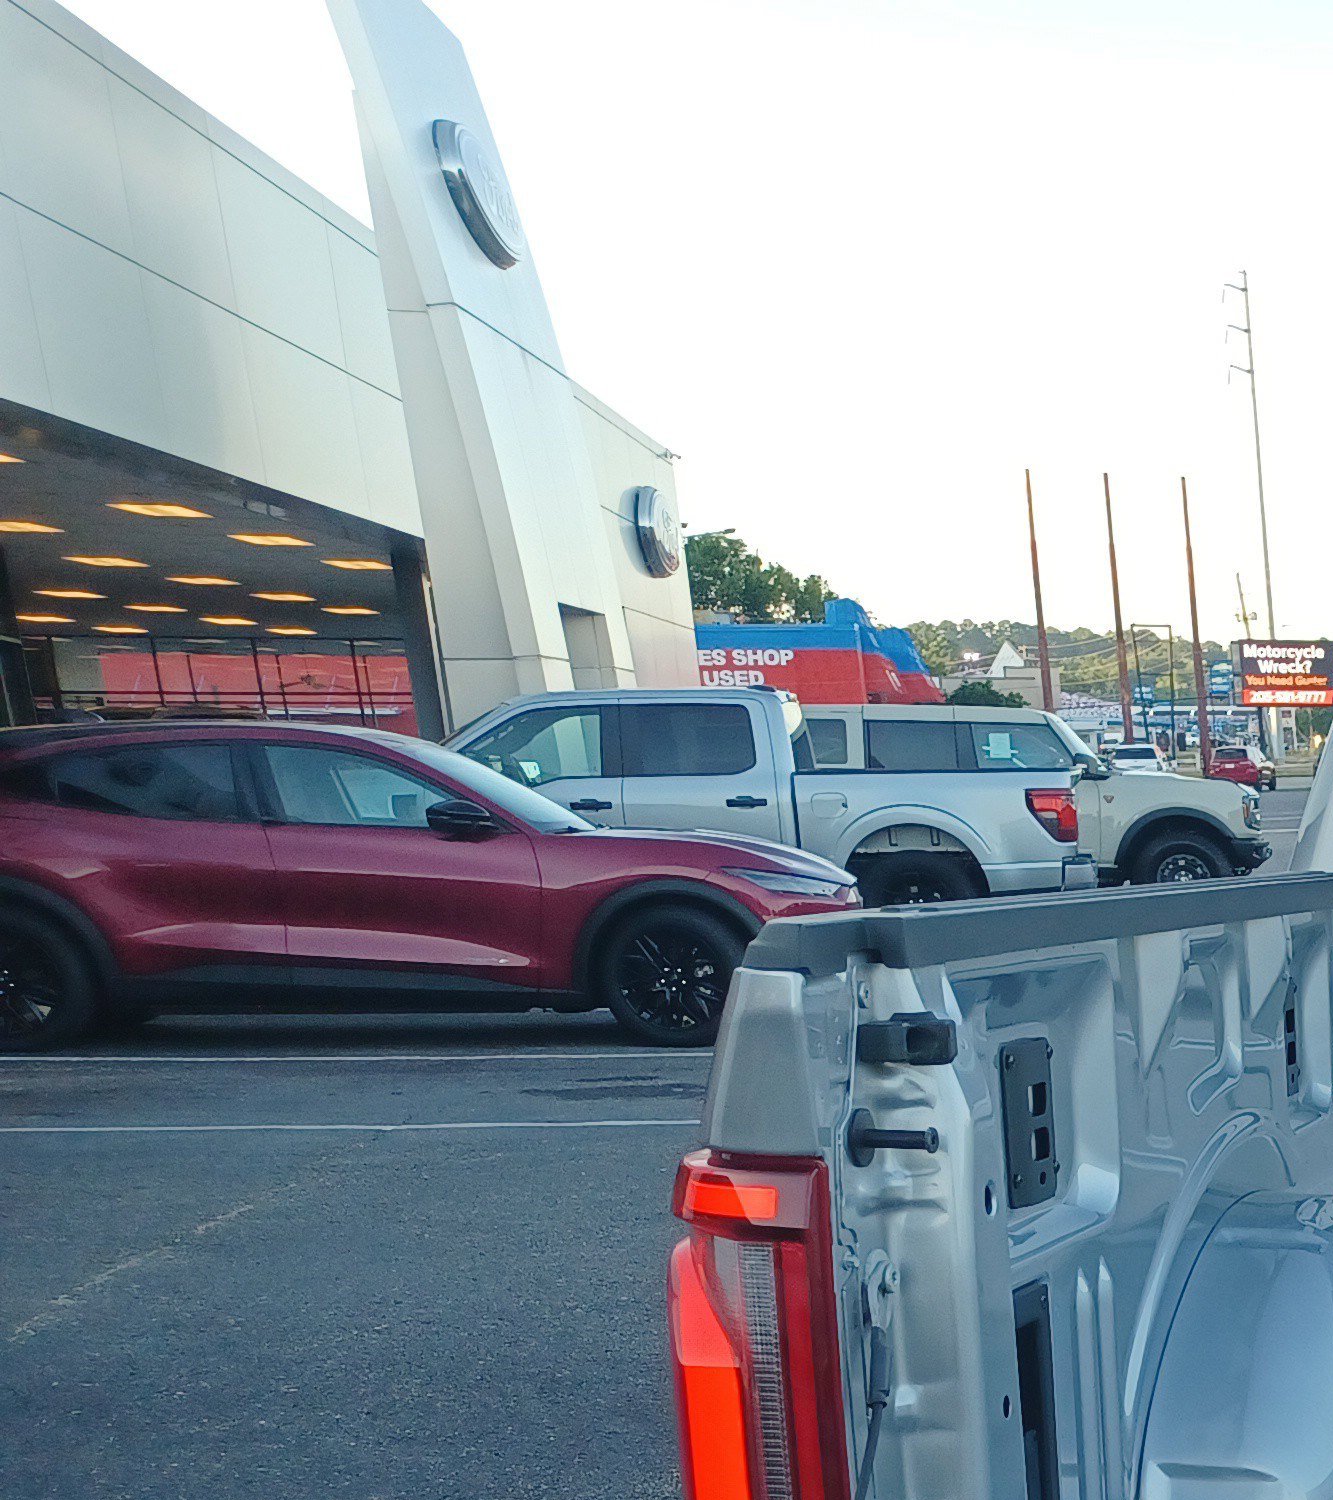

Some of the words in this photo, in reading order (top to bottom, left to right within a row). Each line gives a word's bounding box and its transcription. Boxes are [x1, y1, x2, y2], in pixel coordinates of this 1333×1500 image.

[732, 649, 795, 667] SHOP
[1242, 643, 1325, 660] Motorcycle
[1257, 659, 1313, 674] Wreck?
[703, 670, 765, 687] USED
[1244, 675, 1266, 686] You
